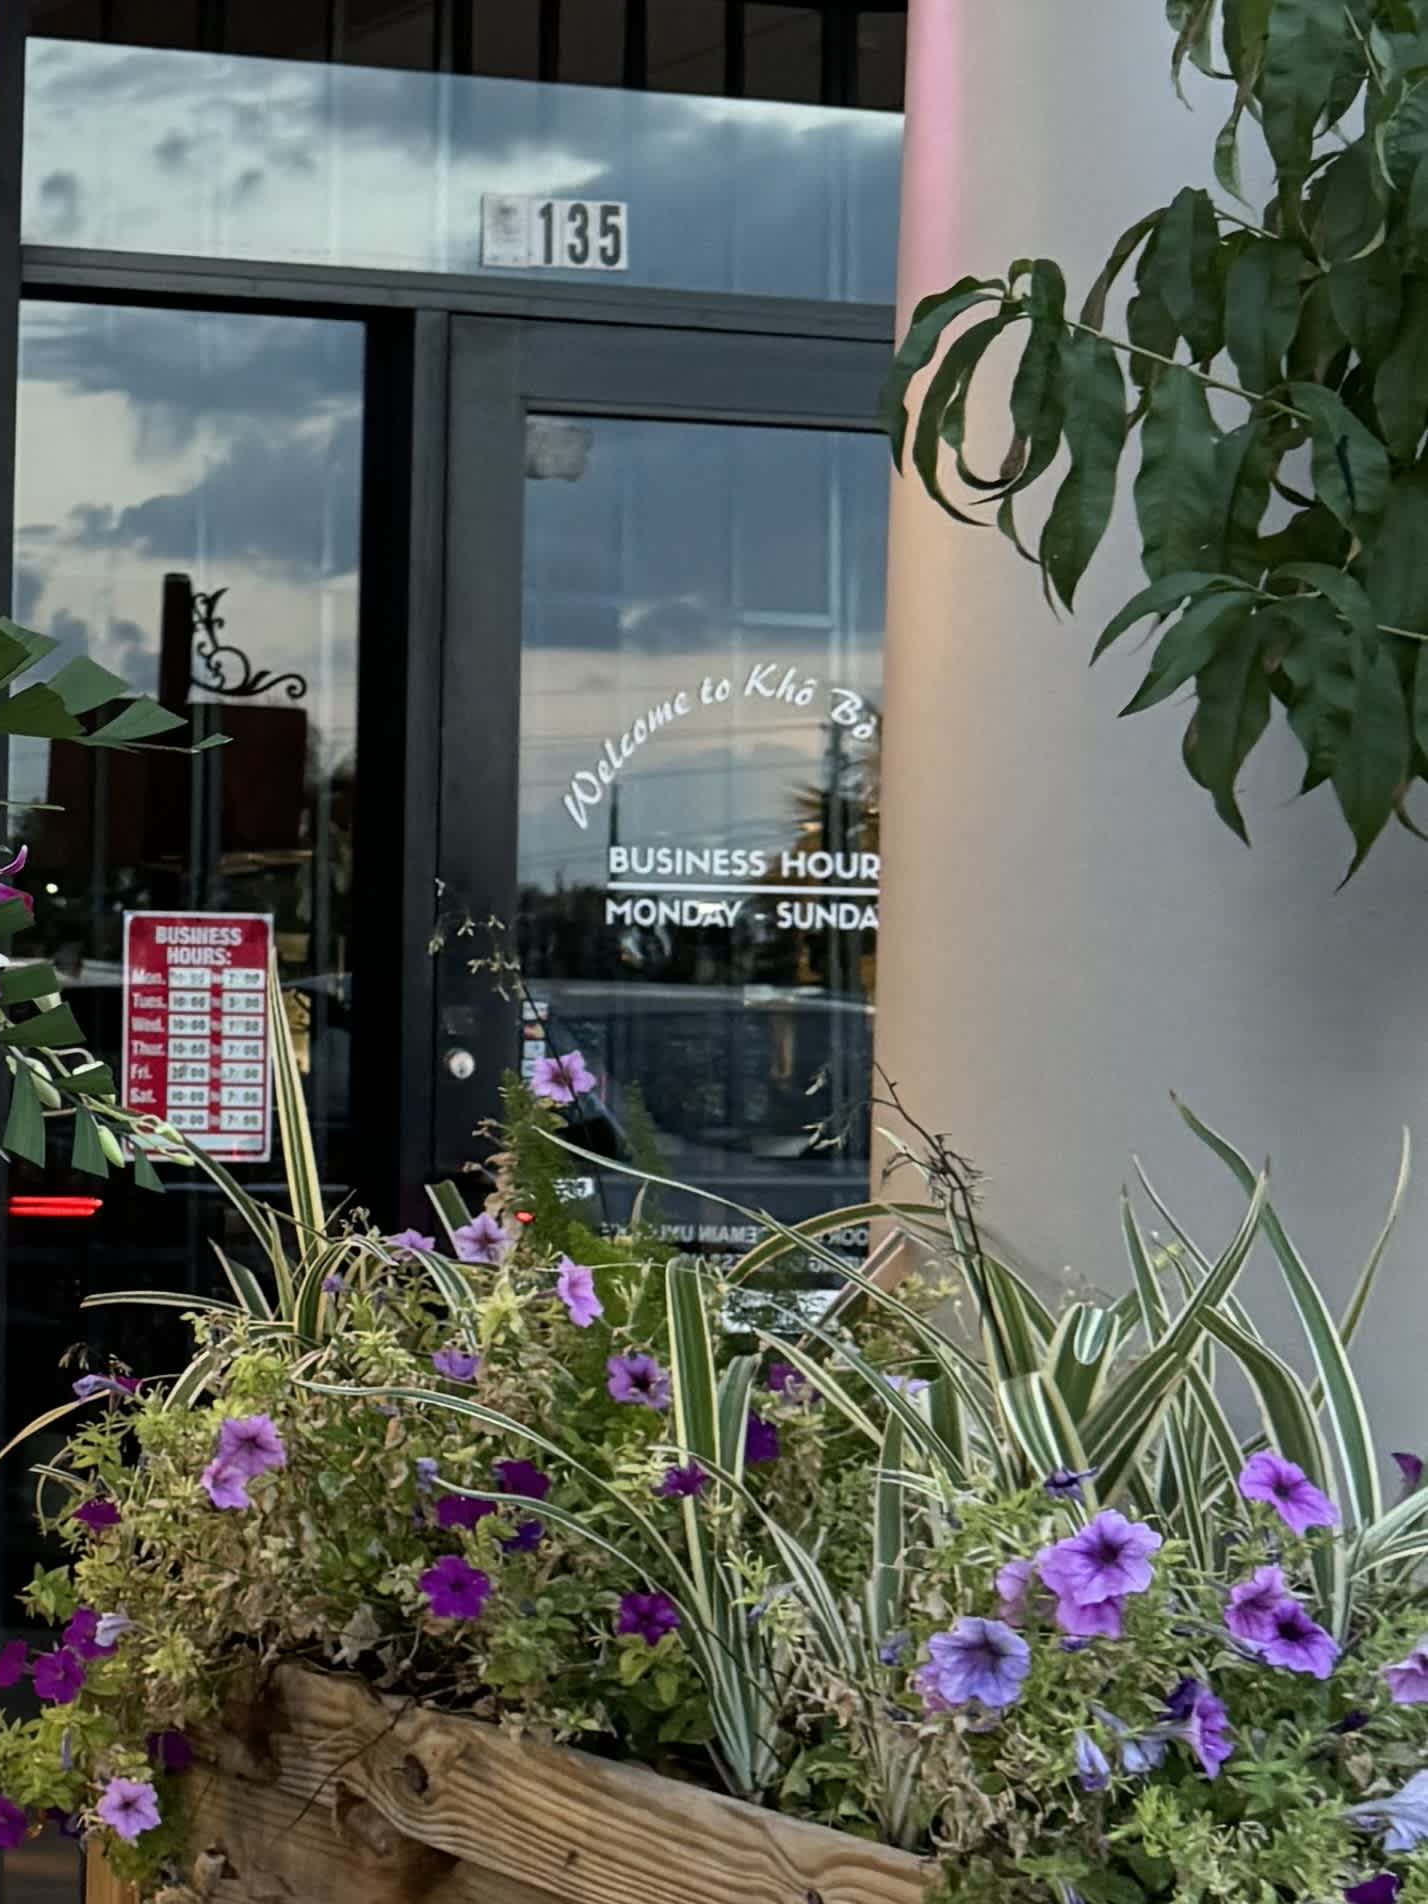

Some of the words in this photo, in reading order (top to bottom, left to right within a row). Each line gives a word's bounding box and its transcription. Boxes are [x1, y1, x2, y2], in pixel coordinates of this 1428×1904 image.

[537, 201, 622, 267] 135
[562, 692, 691, 830] Welcome
[700, 676, 730, 705] to
[609, 847, 767, 878] BUSINESS
[781, 851, 880, 881] HOUR
[604, 899, 743, 929] MONDAY
[776, 901, 880, 930] SUNDA
[155, 926, 243, 946] BUSINESS
[166, 947, 232, 966] HOURS:
